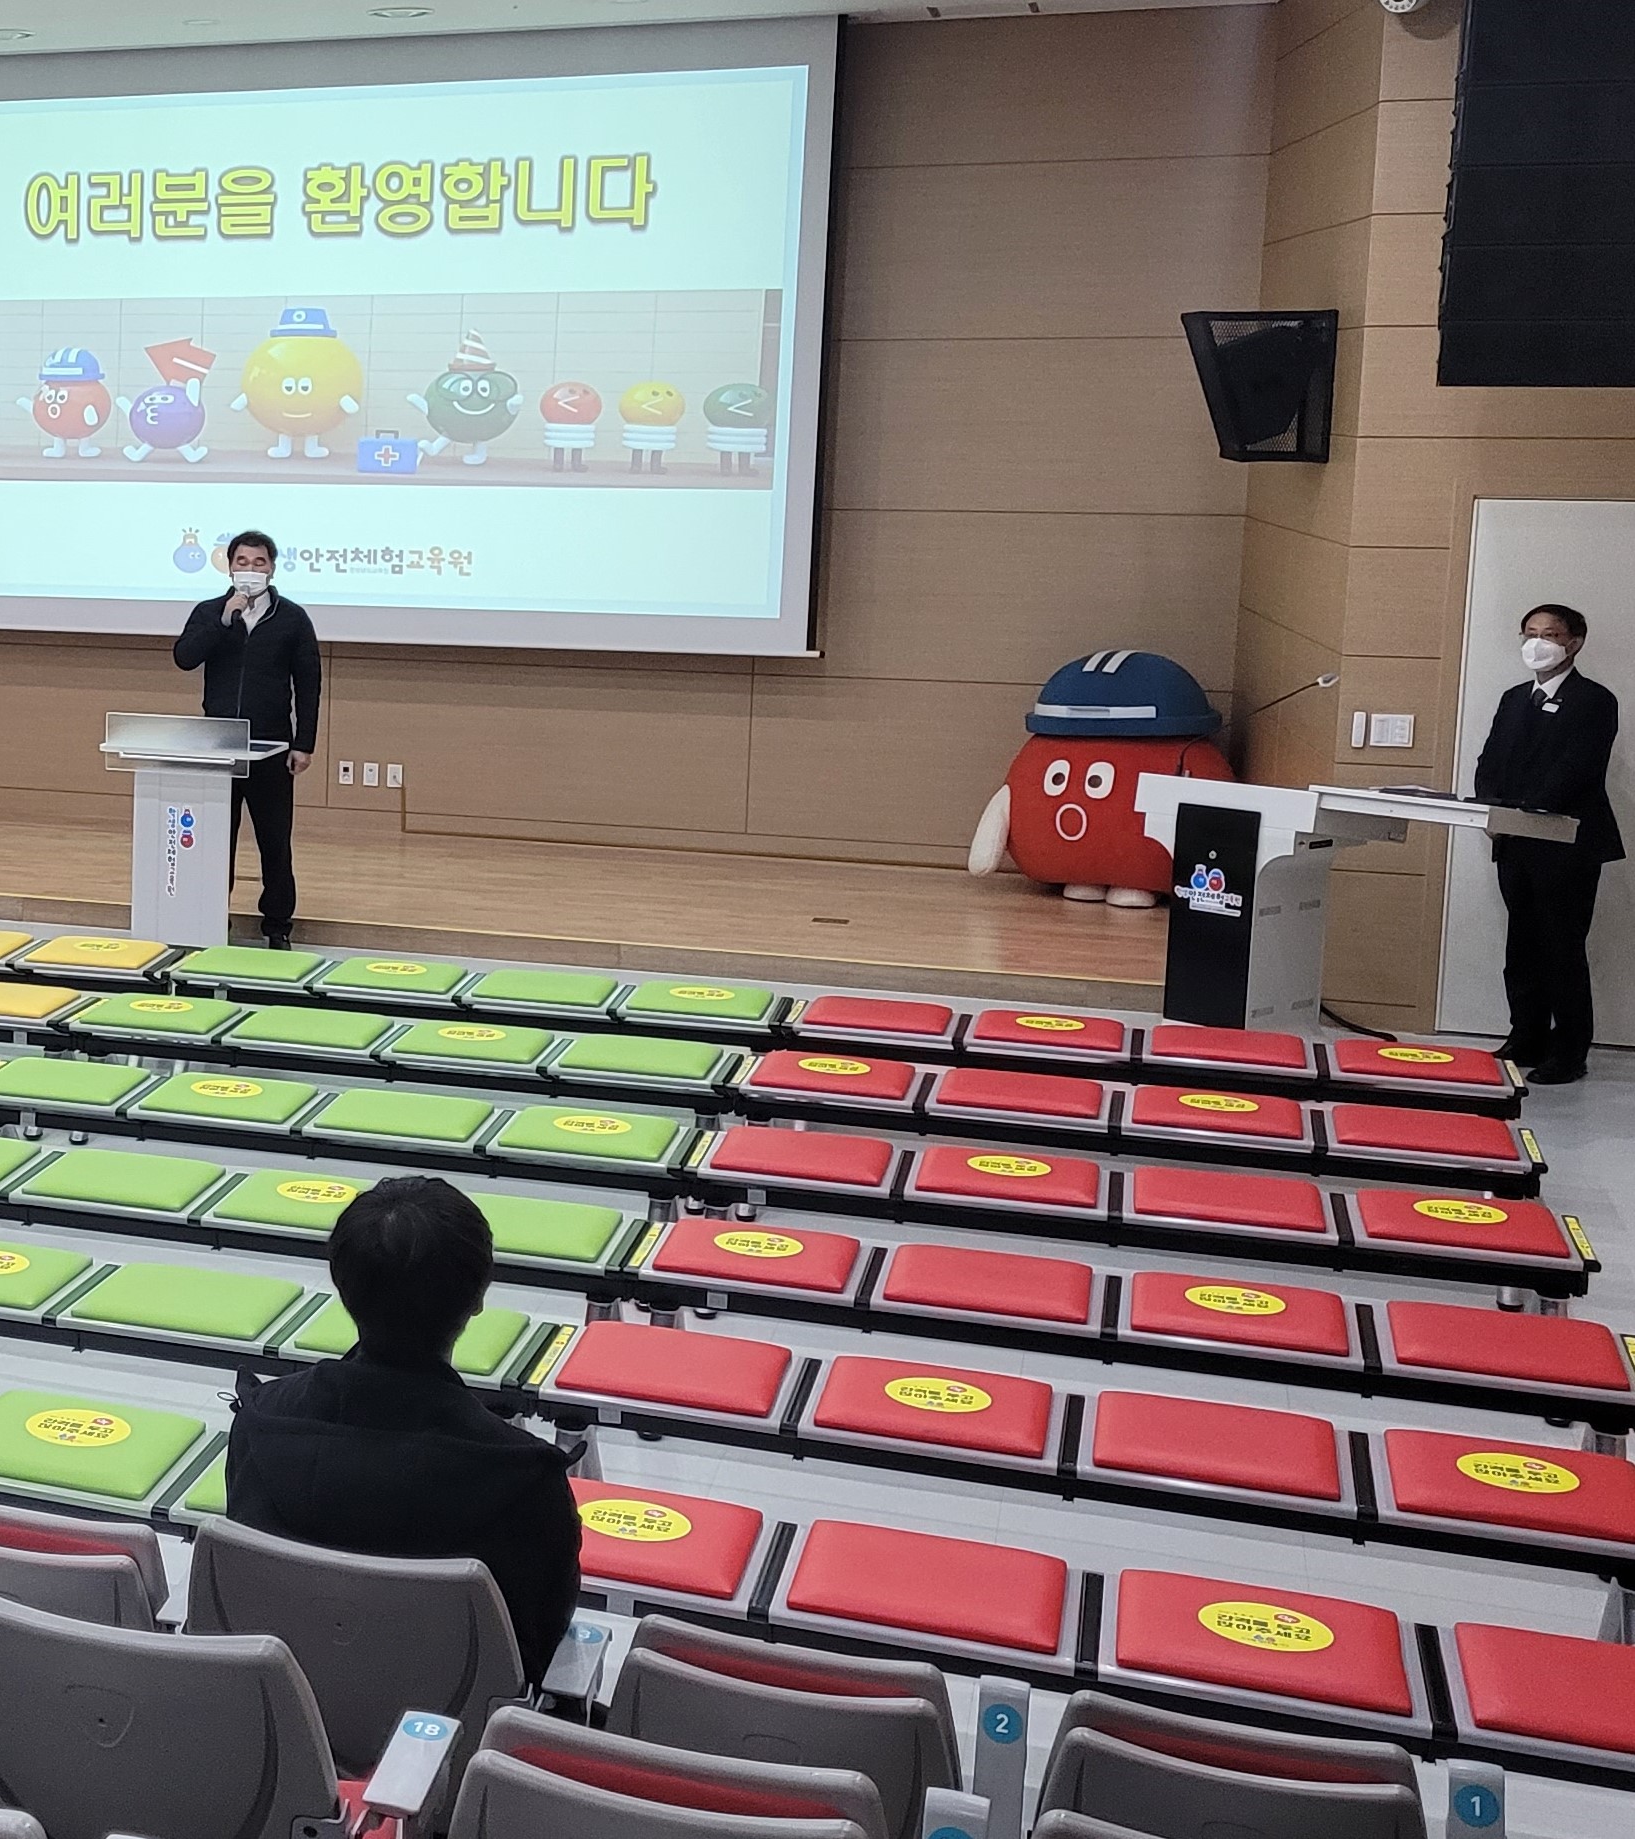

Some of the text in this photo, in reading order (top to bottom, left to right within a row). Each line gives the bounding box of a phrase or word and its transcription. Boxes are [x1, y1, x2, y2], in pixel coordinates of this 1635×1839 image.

[26, 154, 657, 242] 여러분을 환영합니다
[278, 546, 473, 577] 생안전체험교육원
[413, 1721, 441, 1736] 18
[995, 1713, 1009, 1734] 2
[1470, 1795, 1481, 1817] 1
